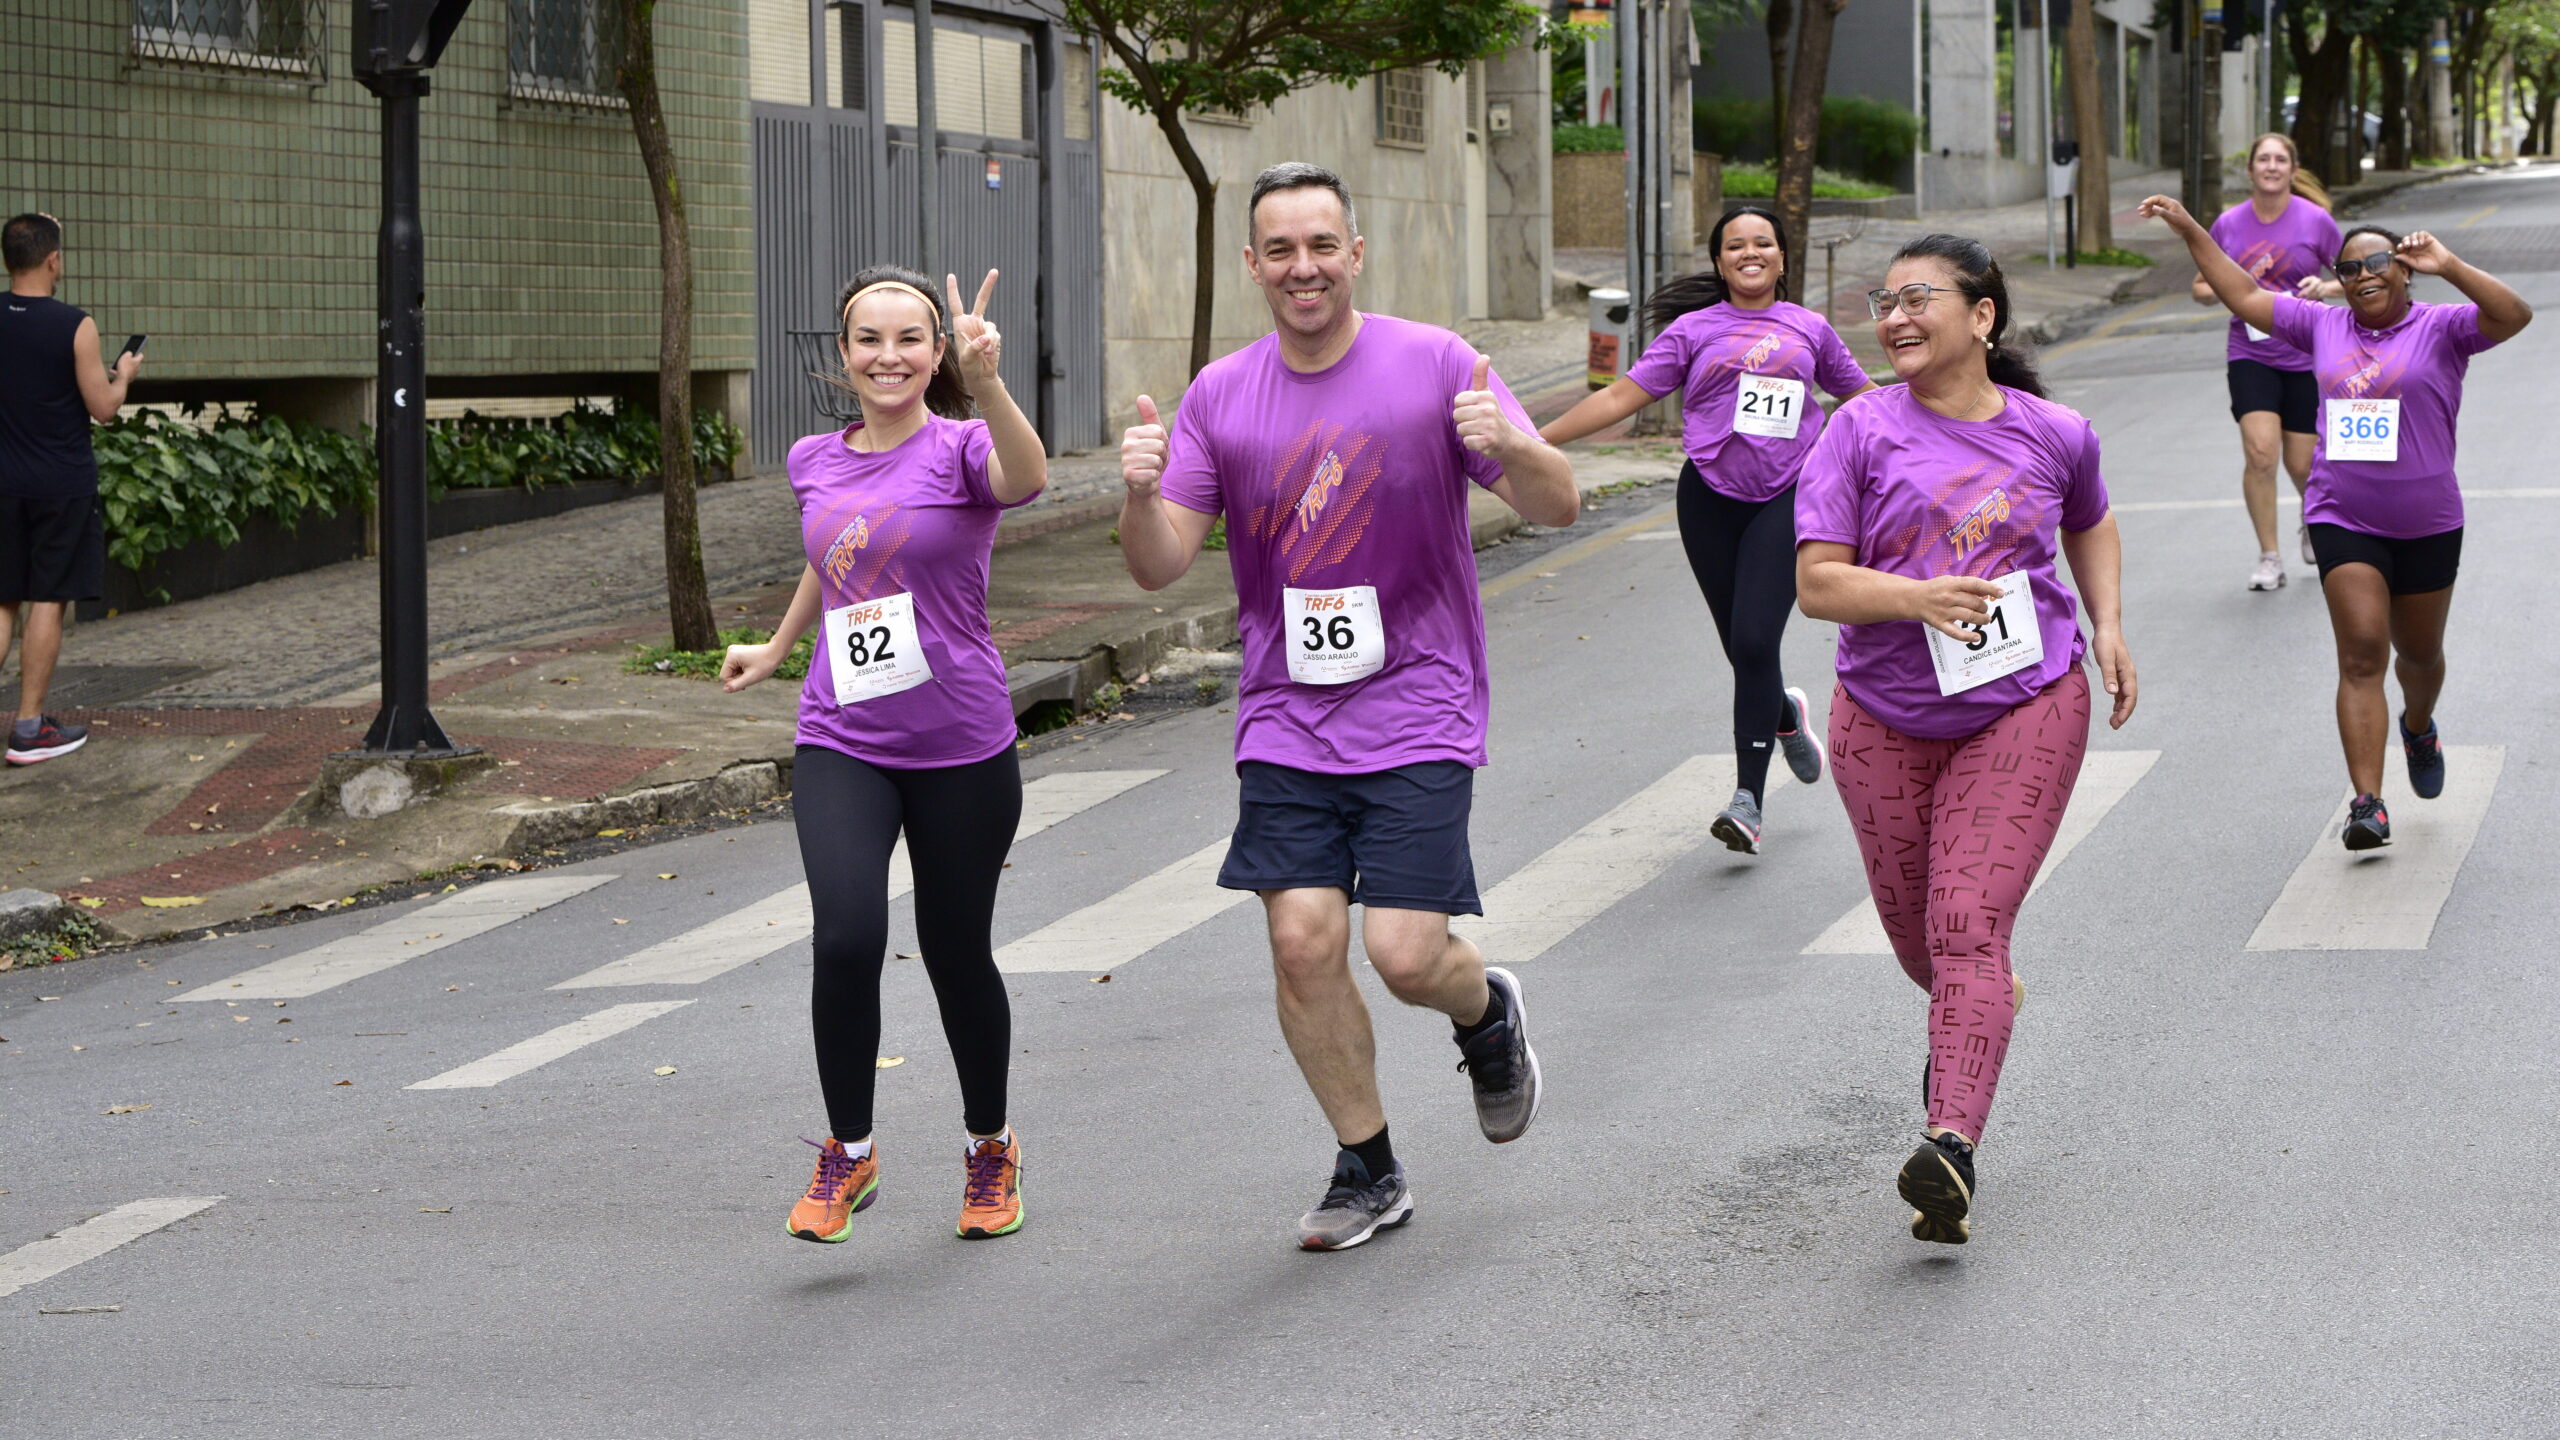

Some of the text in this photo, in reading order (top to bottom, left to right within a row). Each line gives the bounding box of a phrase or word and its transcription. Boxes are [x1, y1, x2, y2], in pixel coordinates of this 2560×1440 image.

[1755, 380, 1785, 392] TRF6
[1742, 391, 1791, 418] 211
[2351, 403, 2378, 413] TRF6
[2339, 416, 2390, 439] 366
[1298, 455, 1343, 532] TRF6
[1953, 514, 1972, 533] corrida
[1992, 487, 2001, 496] do
[1950, 491, 2010, 561] TRF6
[826, 518, 869, 591] TRF6
[847, 606, 883, 628] TRF6
[1304, 596, 1345, 611] TRF6
[847, 625, 896, 667] 82
[1303, 616, 1354, 651] 36
[1328, 650, 1359, 661] ARAÚJO
[1963, 650, 1993, 665] CANDICE
[1993, 638, 2023, 655] SANTANA
[880, 662, 896, 672] LIMA
